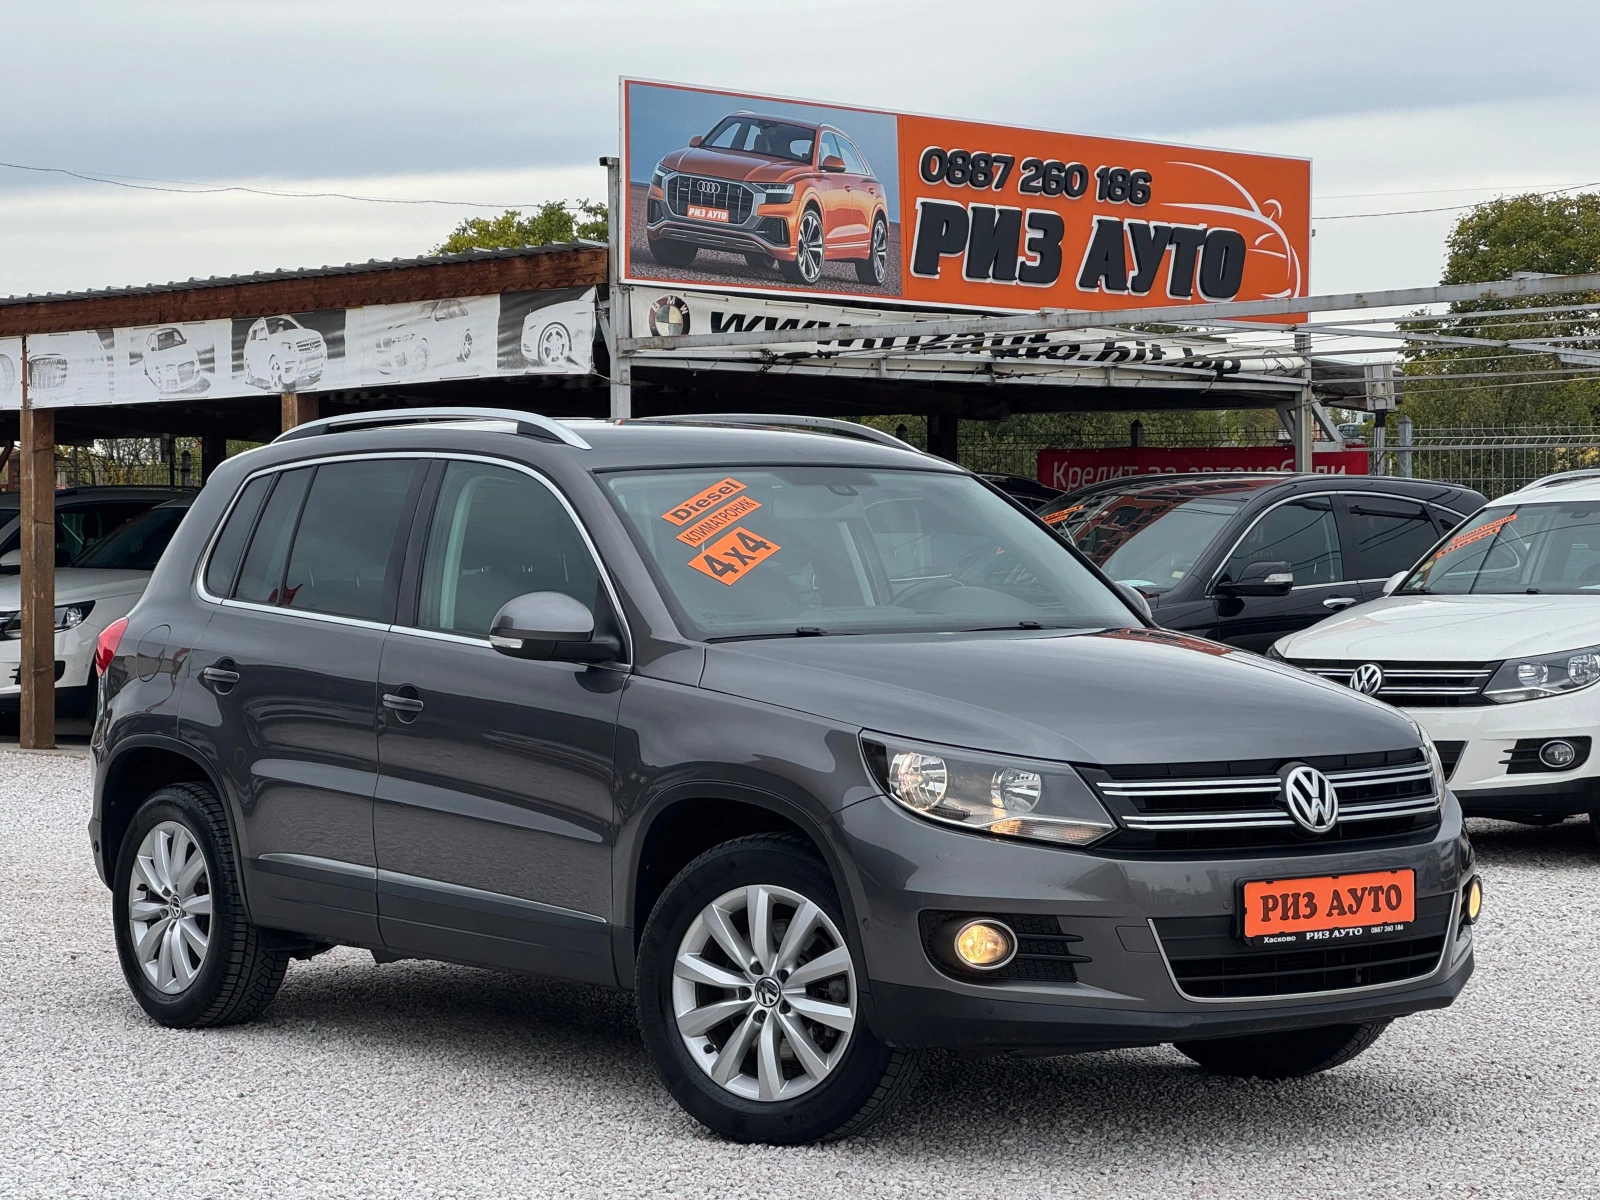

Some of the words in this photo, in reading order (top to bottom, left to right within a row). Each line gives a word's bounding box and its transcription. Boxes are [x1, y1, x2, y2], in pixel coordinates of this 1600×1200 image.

[920, 146, 1014, 191] 0887
[1018, 156, 1089, 200] 260
[1095, 165, 1152, 206] 186
[688, 207, 706, 217] РИЗ
[706, 209, 728, 220] АУТО
[911, 197, 1065, 288] РИЗ
[1076, 215, 1246, 302] АУТО
[671, 481, 741, 521] Diesel
[683, 498, 756, 543] КЛИМАТРОНИК
[1260, 891, 1318, 922] РИЗ
[1325, 884, 1403, 918] АУТО
[1263, 935, 1297, 944] Хасково
[1305, 931, 1330, 941] РИЗ
[1331, 927, 1363, 939] АУТО
